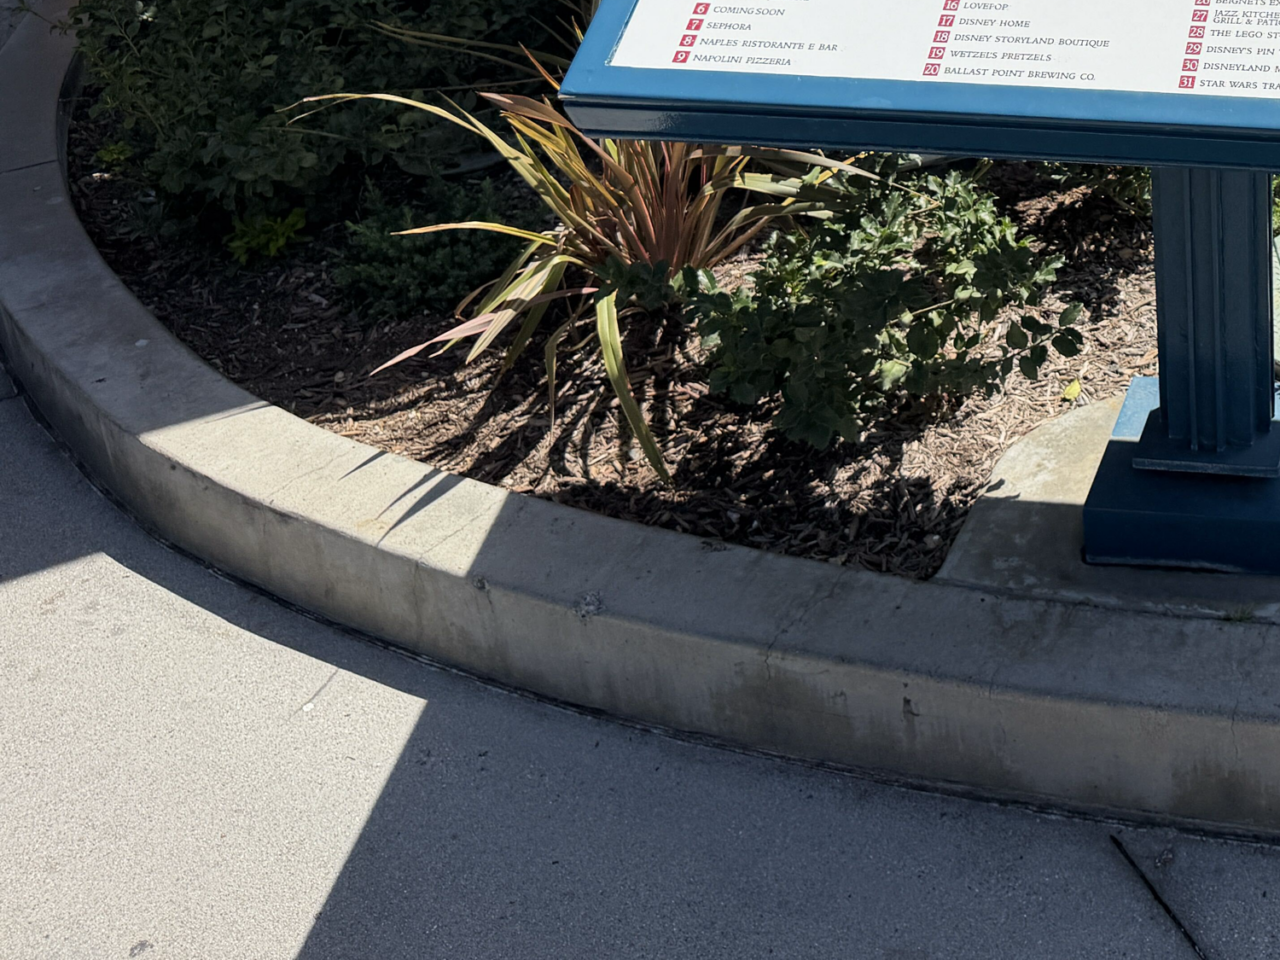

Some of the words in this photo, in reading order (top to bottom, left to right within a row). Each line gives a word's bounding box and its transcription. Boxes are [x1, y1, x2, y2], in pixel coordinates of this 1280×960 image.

[713, 6, 754, 15] COMING
[755, 7, 785, 16] SOON
[706, 22, 751, 30] SEPHORA
[941, 16, 953, 25] 17
[959, 18, 996, 26] DISNEY
[1190, 28, 1204, 37] 28
[699, 38, 738, 47] NAPLES
[742, 40, 804, 50] RISTORANTE
[819, 43, 838, 51] BAR
[936, 32, 949, 42] 18
[954, 34, 992, 42] DISNEY
[995, 36, 1054, 45] STORYLAND
[1059, 39, 1110, 47] BOUTIQUE
[931, 48, 944, 58] 19
[1001, 53, 1052, 61] PRETZELS
[1187, 44, 1200, 53] 29
[1206, 46, 1252, 54] DISNEY'S
[693, 55, 742, 64] NAPOLINI
[746, 57, 791, 66] PIZZERIA
[924, 65, 939, 74] 20
[944, 67, 988, 76] BALLAST
[1028, 71, 1076, 79] BREWING
[1183, 61, 1198, 70] 30
[1203, 63, 1270, 72] DISNEYLAND
[1180, 78, 1192, 87] 31
[1229, 81, 1258, 89] WARS
